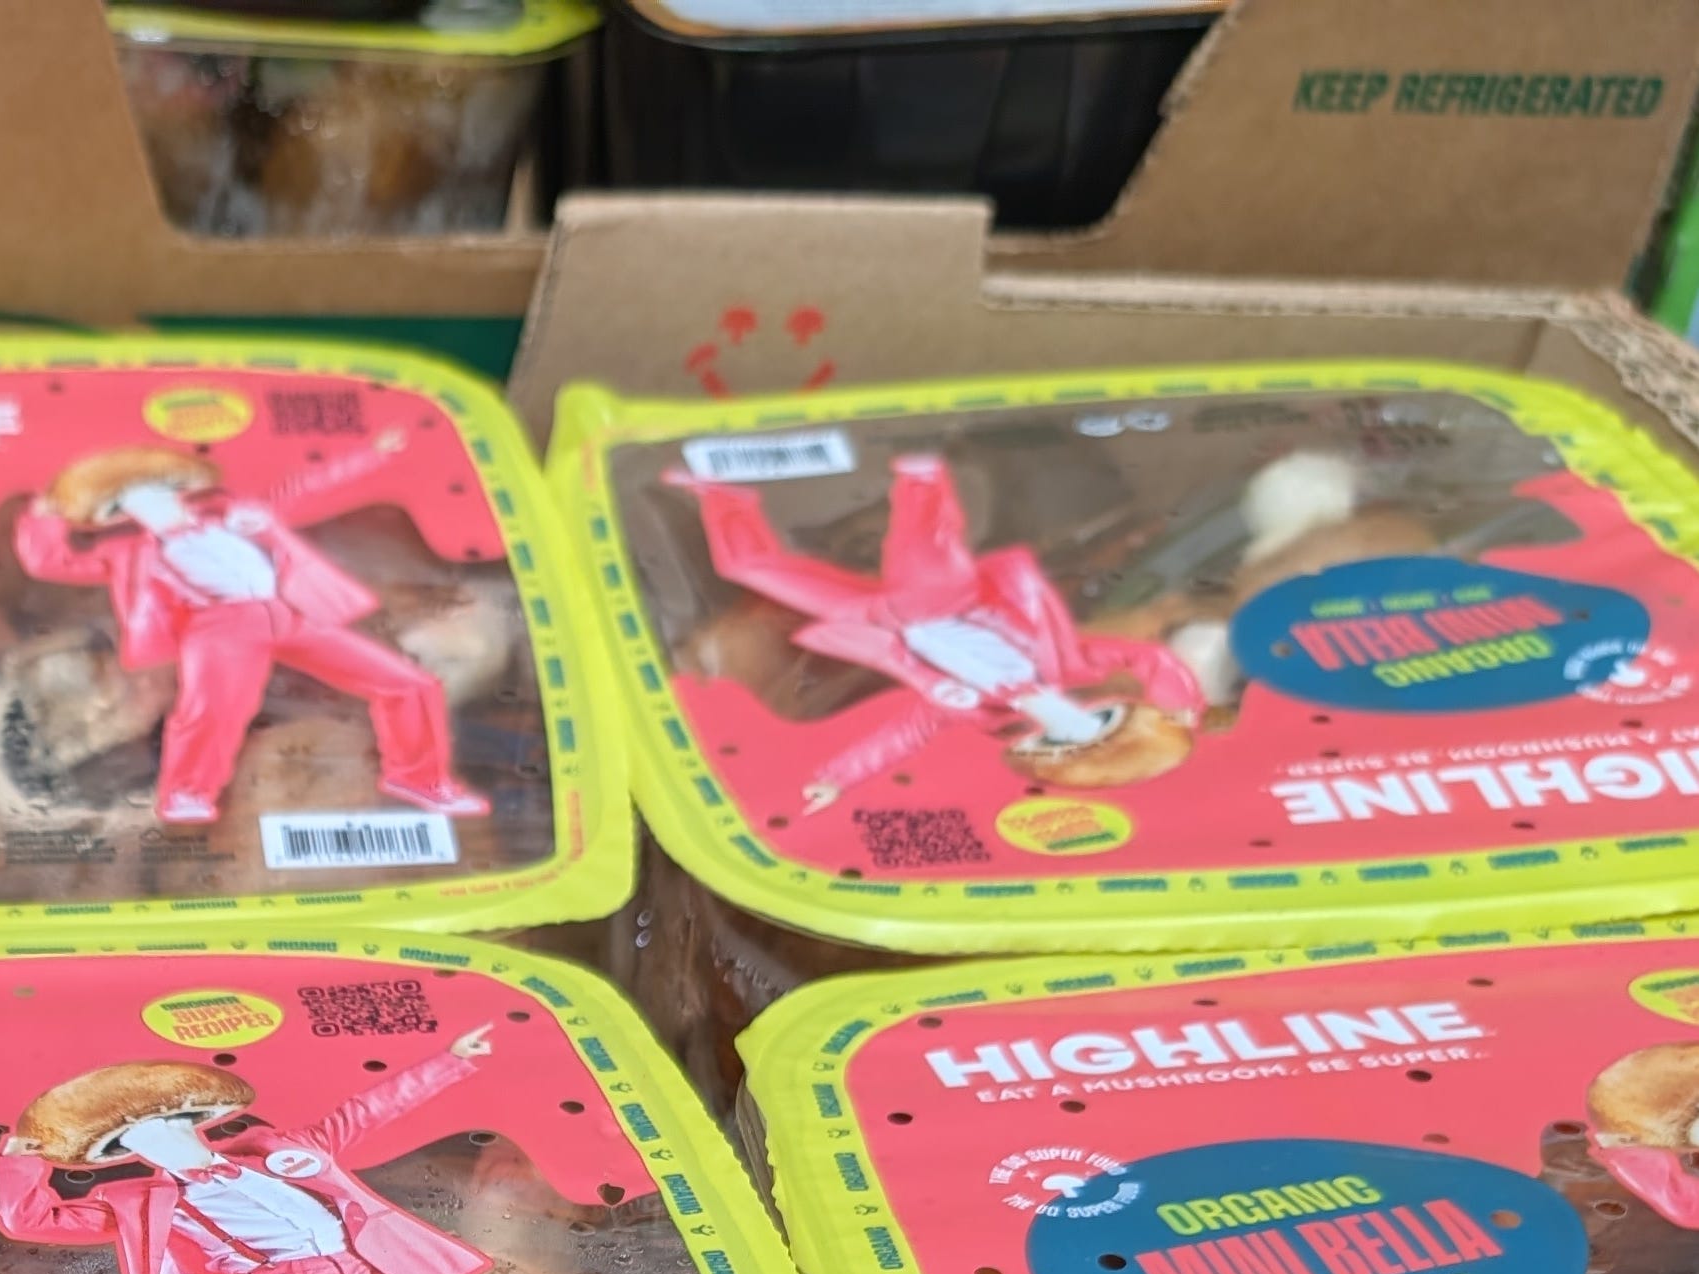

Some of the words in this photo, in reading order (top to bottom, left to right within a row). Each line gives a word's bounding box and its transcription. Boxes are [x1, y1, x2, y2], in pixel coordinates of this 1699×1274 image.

[1293, 69, 1389, 114] KEEP
[1392, 72, 1665, 118] REFRIGERATED
[1371, 632, 1555, 689] ORGANIC
[1269, 746, 1699, 825] IGHLINE
[172, 1004, 253, 1023] SUPER
[173, 1013, 275, 1041] RECIPES
[924, 1002, 1484, 1088] HIGHLINE
[975, 1086, 1040, 1102] EAT
[1051, 1084, 1074, 1098] A
[1307, 1057, 1351, 1075] BE
[1156, 1174, 1383, 1236] ORGANIC
